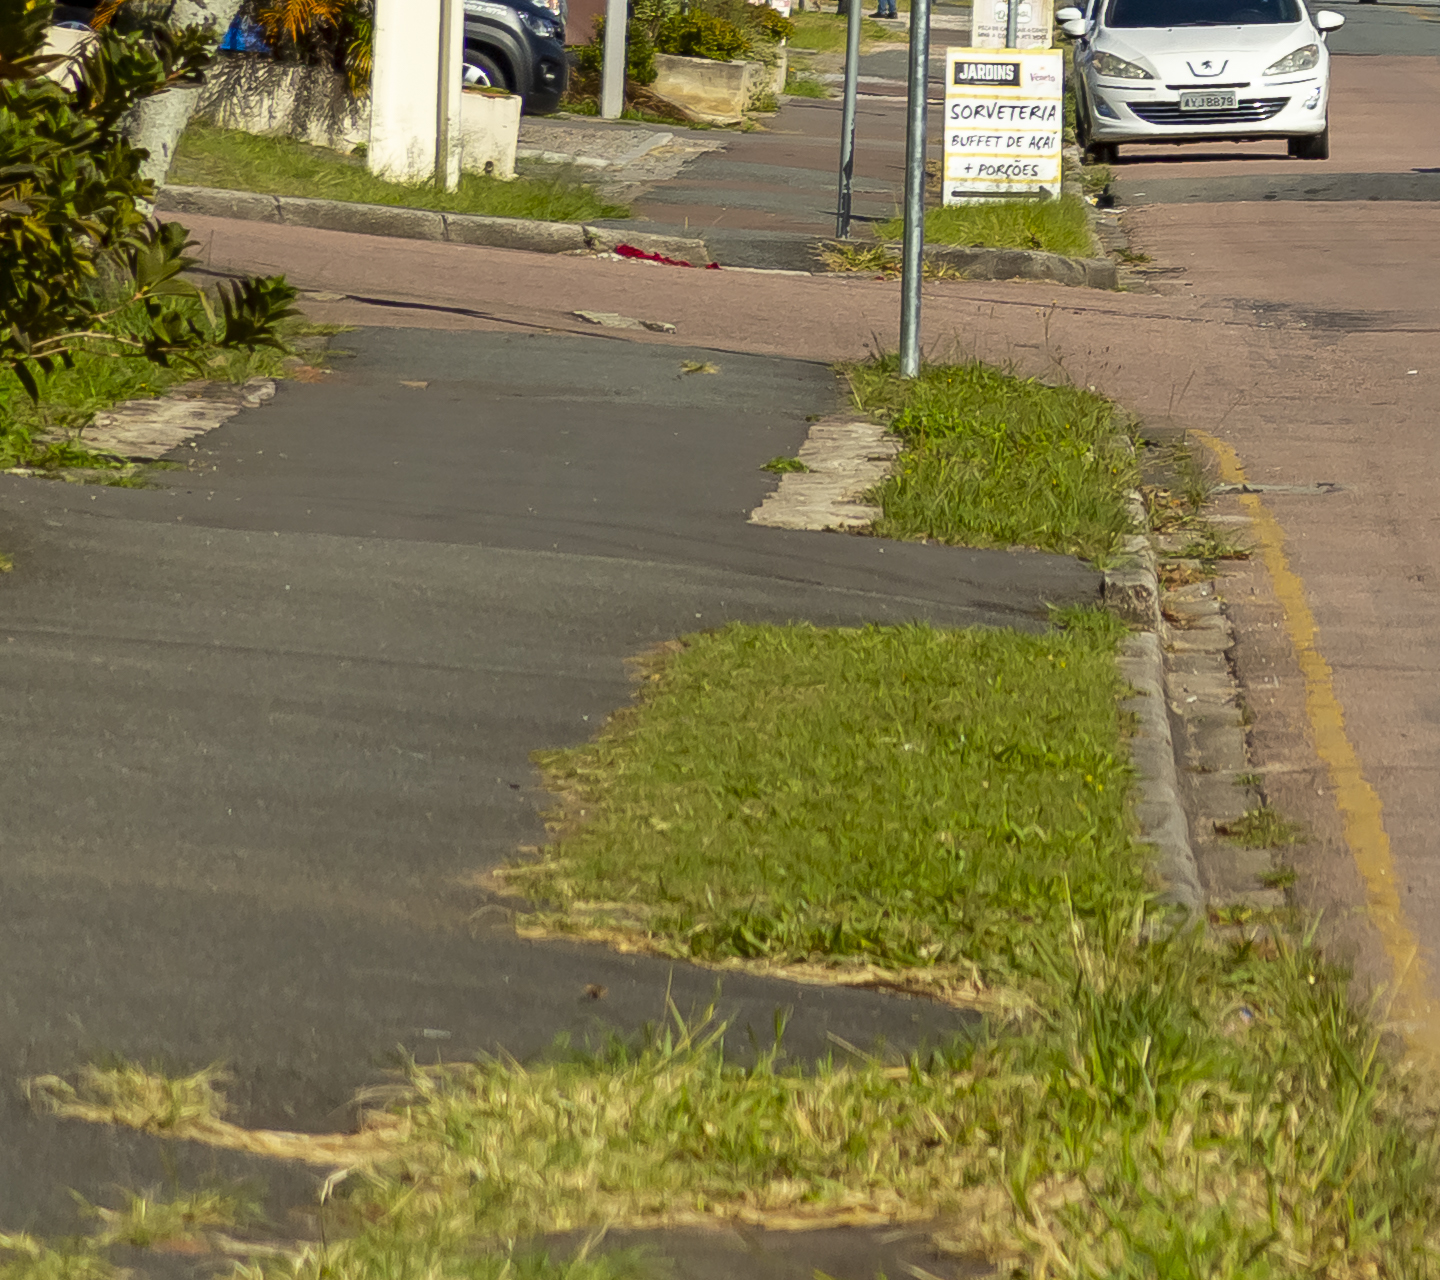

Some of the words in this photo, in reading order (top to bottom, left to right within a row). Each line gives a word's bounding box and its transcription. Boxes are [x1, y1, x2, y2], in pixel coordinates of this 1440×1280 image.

[959, 63, 1015, 81] JARDINS
[950, 102, 1057, 122] SORVETERIA
[951, 134, 1003, 148] BUFFET
[1006, 136, 1025, 148] DE
[1028, 131, 1058, 151] AÇAÍ
[977, 159, 1039, 179] PORÇÕES
